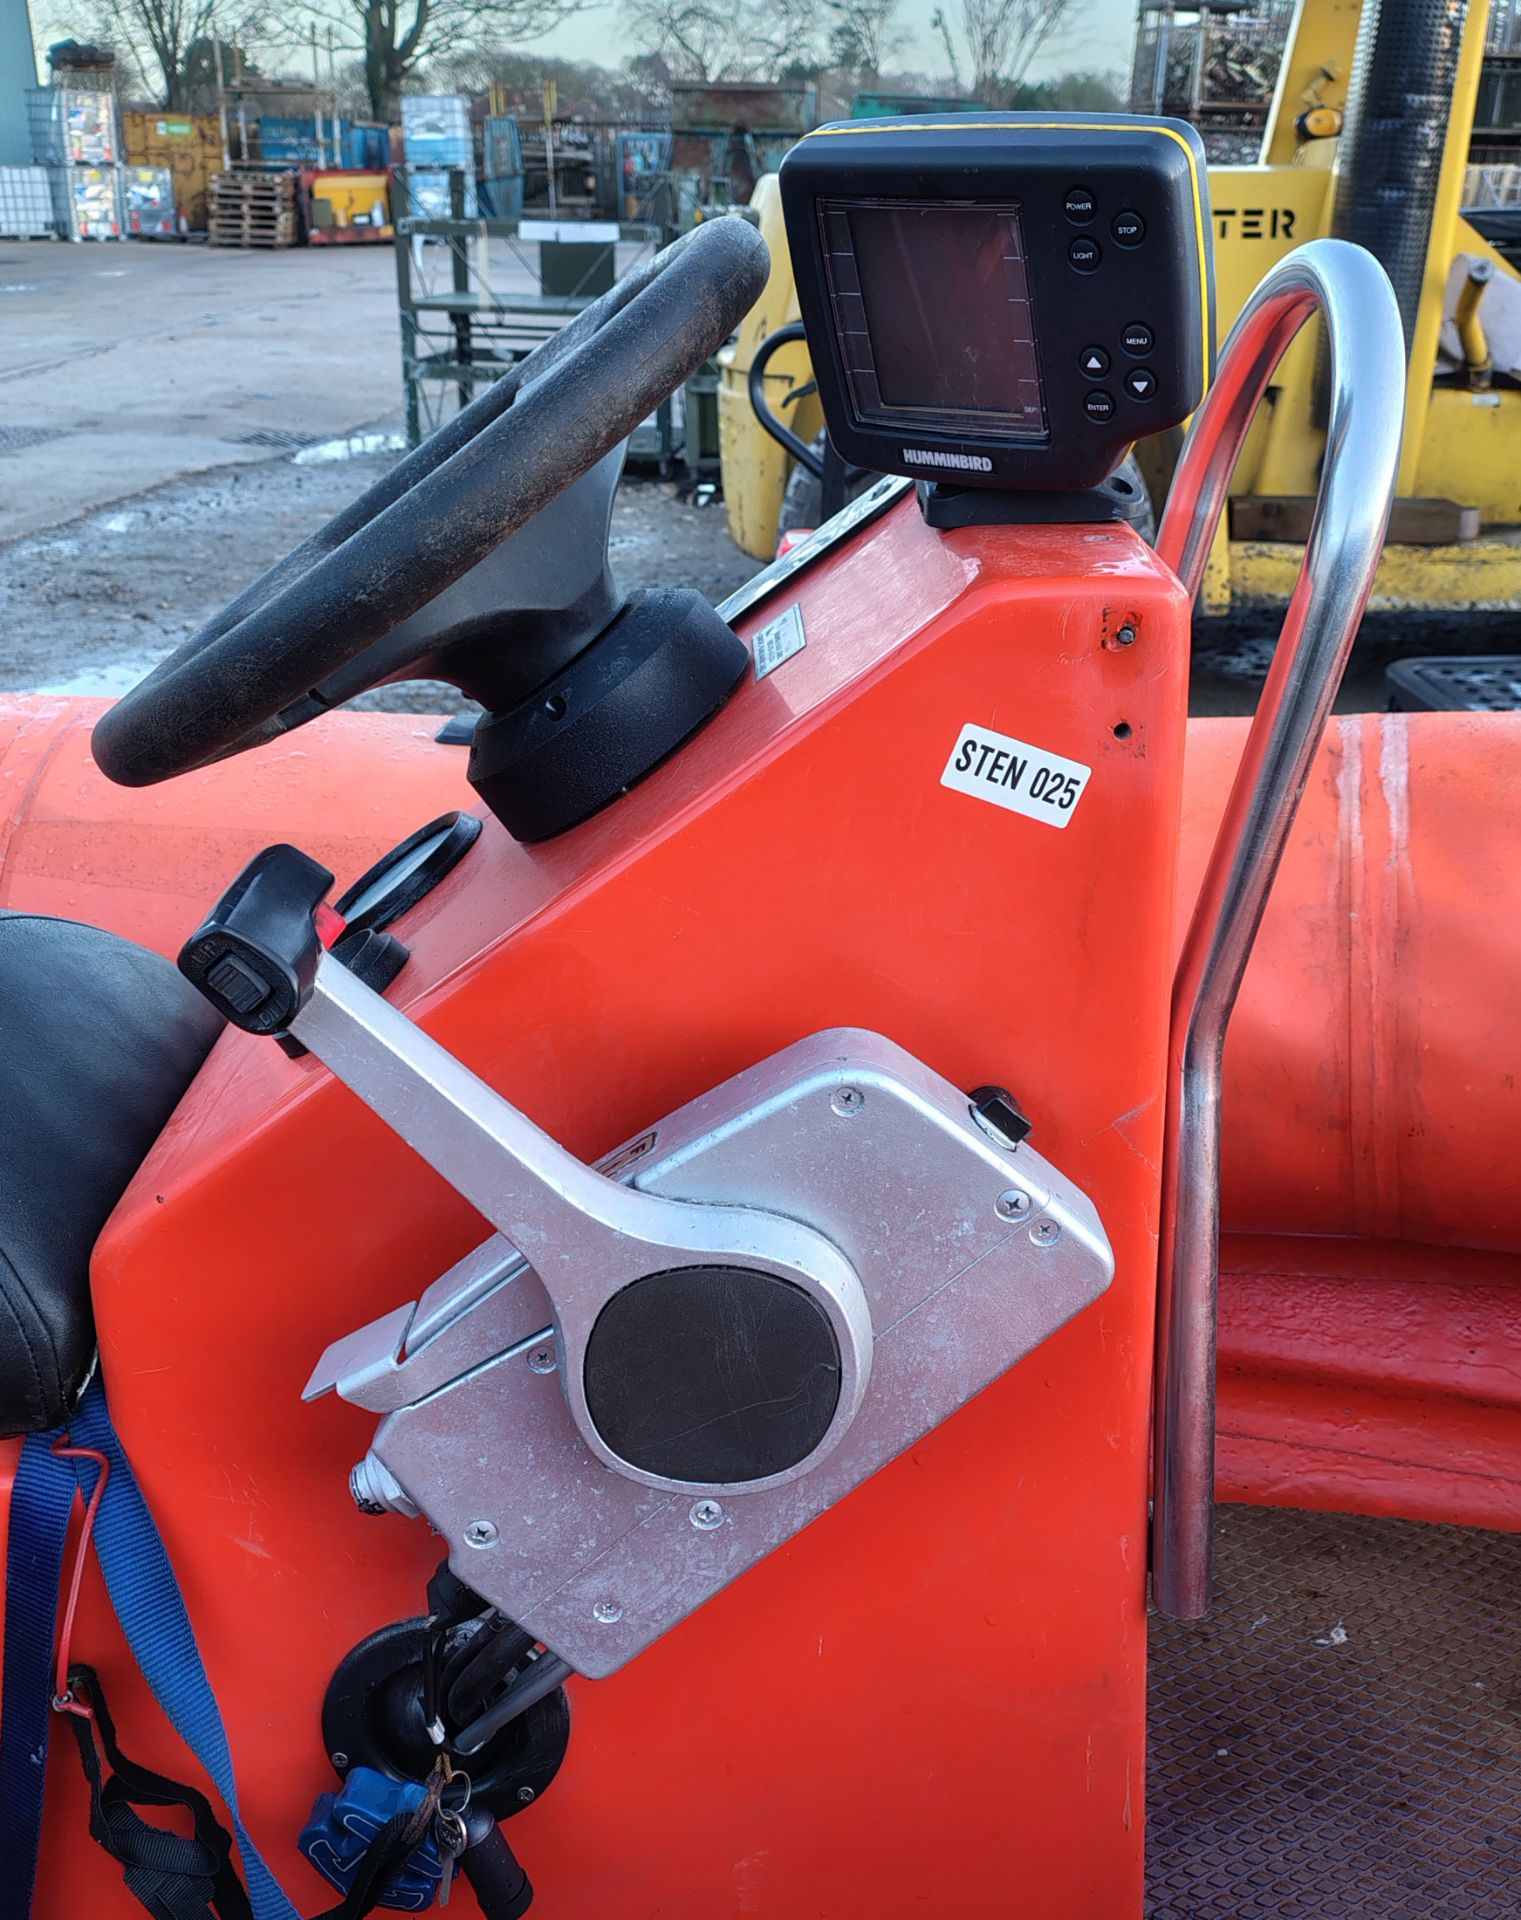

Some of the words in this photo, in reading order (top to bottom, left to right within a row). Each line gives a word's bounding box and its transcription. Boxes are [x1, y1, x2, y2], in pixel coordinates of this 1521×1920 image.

[1066, 201, 1092, 211] POWER
[1117, 226, 1137, 235] STOP
[1073, 251, 1093, 260] LIGHT
[1126, 337, 1147, 346] MENU
[1087, 403, 1109, 411] ENTER
[903, 448, 993, 472] HUMMINBIRD
[955, 739, 1028, 791] STEN
[1029, 767, 1081, 809] 025
[191, 939, 218, 965] UP
[258, 1000, 284, 1026] DN
